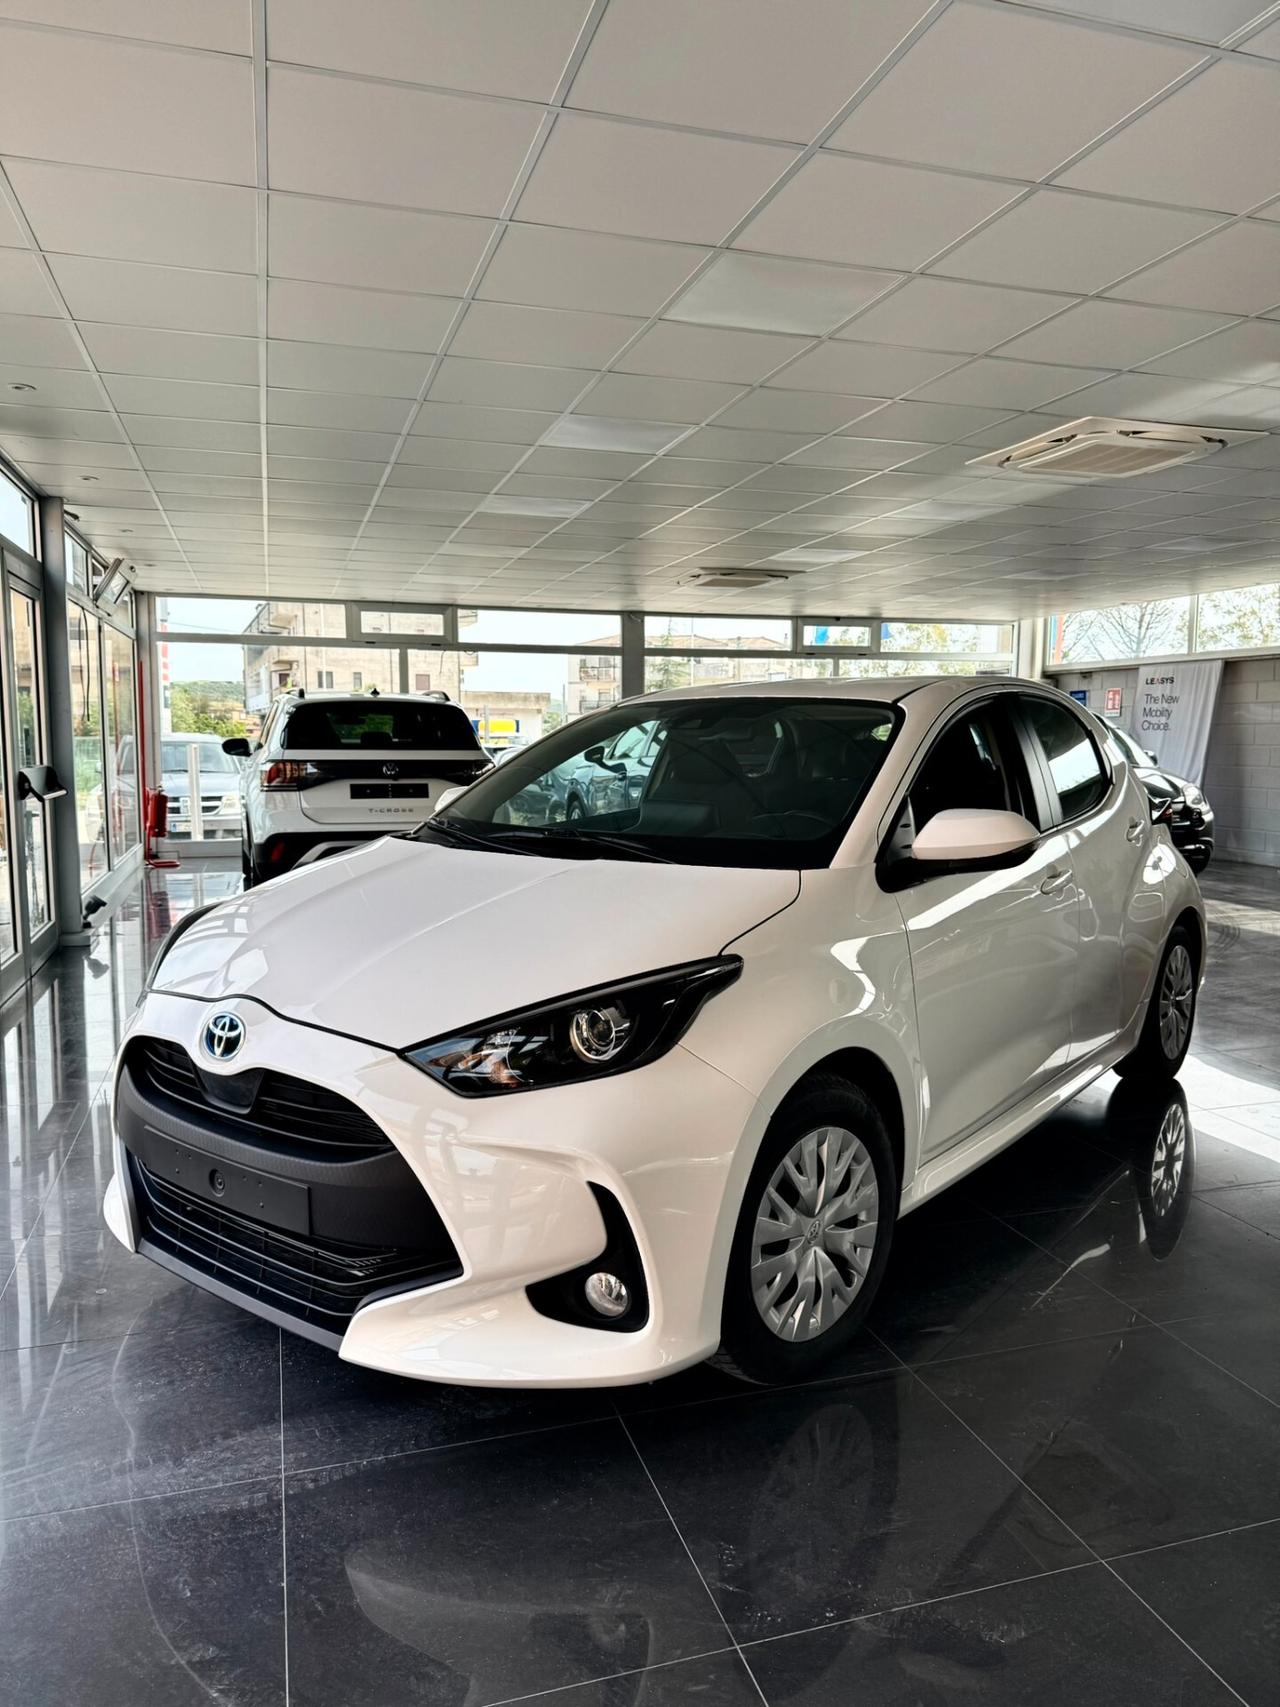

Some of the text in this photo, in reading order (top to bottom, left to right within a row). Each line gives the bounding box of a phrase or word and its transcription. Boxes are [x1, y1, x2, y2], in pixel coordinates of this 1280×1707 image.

[1145, 677, 1174, 685] LEASYS
[1144, 693, 1180, 704] The New
